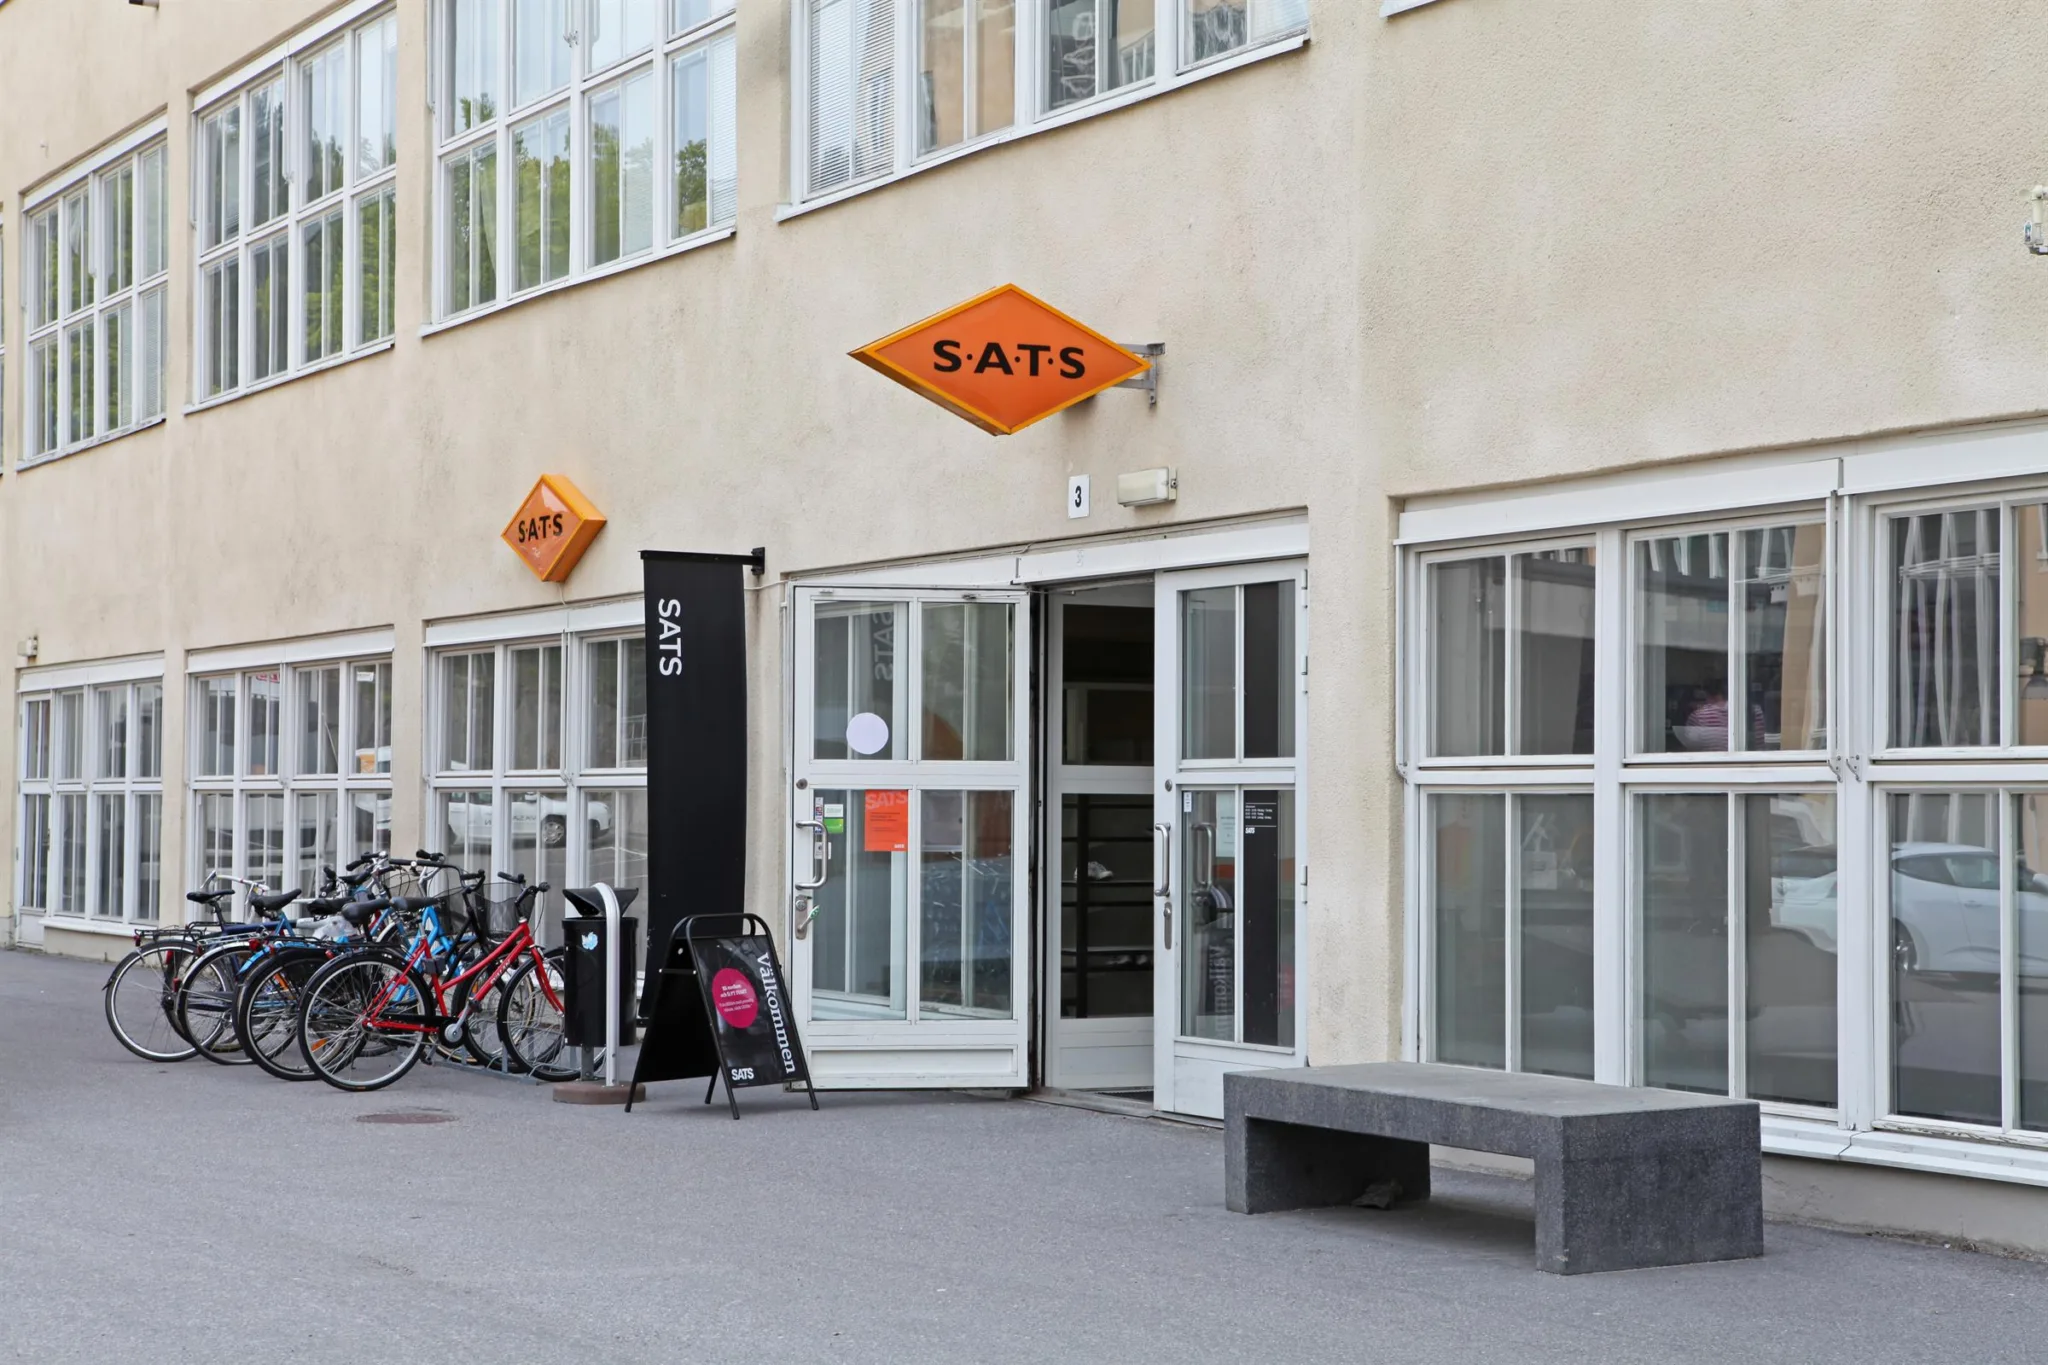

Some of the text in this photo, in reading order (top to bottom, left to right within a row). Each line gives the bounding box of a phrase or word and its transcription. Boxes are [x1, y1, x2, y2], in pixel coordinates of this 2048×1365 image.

[1074, 485, 1083, 508] 3
[658, 598, 682, 676] SATS
[865, 791, 908, 810] SATS
[757, 951, 795, 1074] Välkommen
[731, 1067, 754, 1080] SATS
